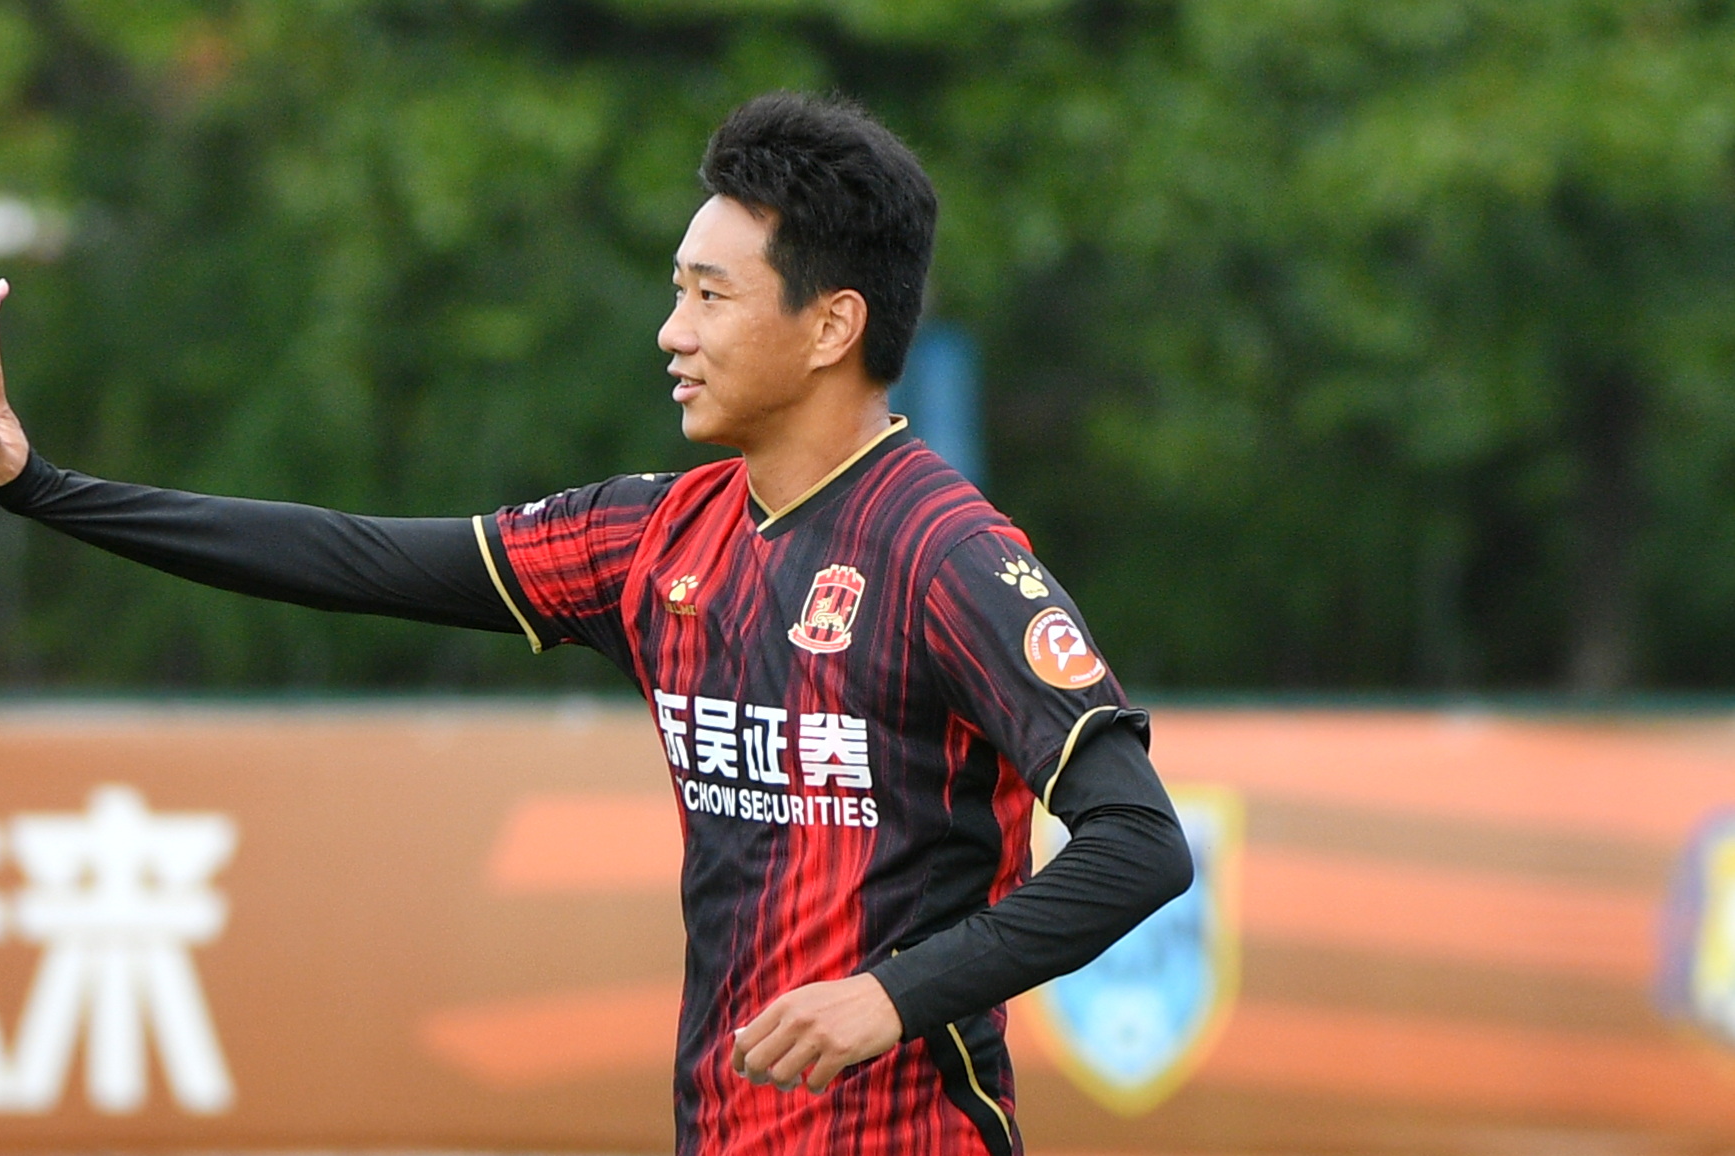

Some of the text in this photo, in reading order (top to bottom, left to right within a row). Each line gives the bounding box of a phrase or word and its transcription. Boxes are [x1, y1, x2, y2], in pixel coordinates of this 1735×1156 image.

[653, 688, 874, 789] 东吴证券
[676, 774, 880, 829] CHOW SECURITIES
